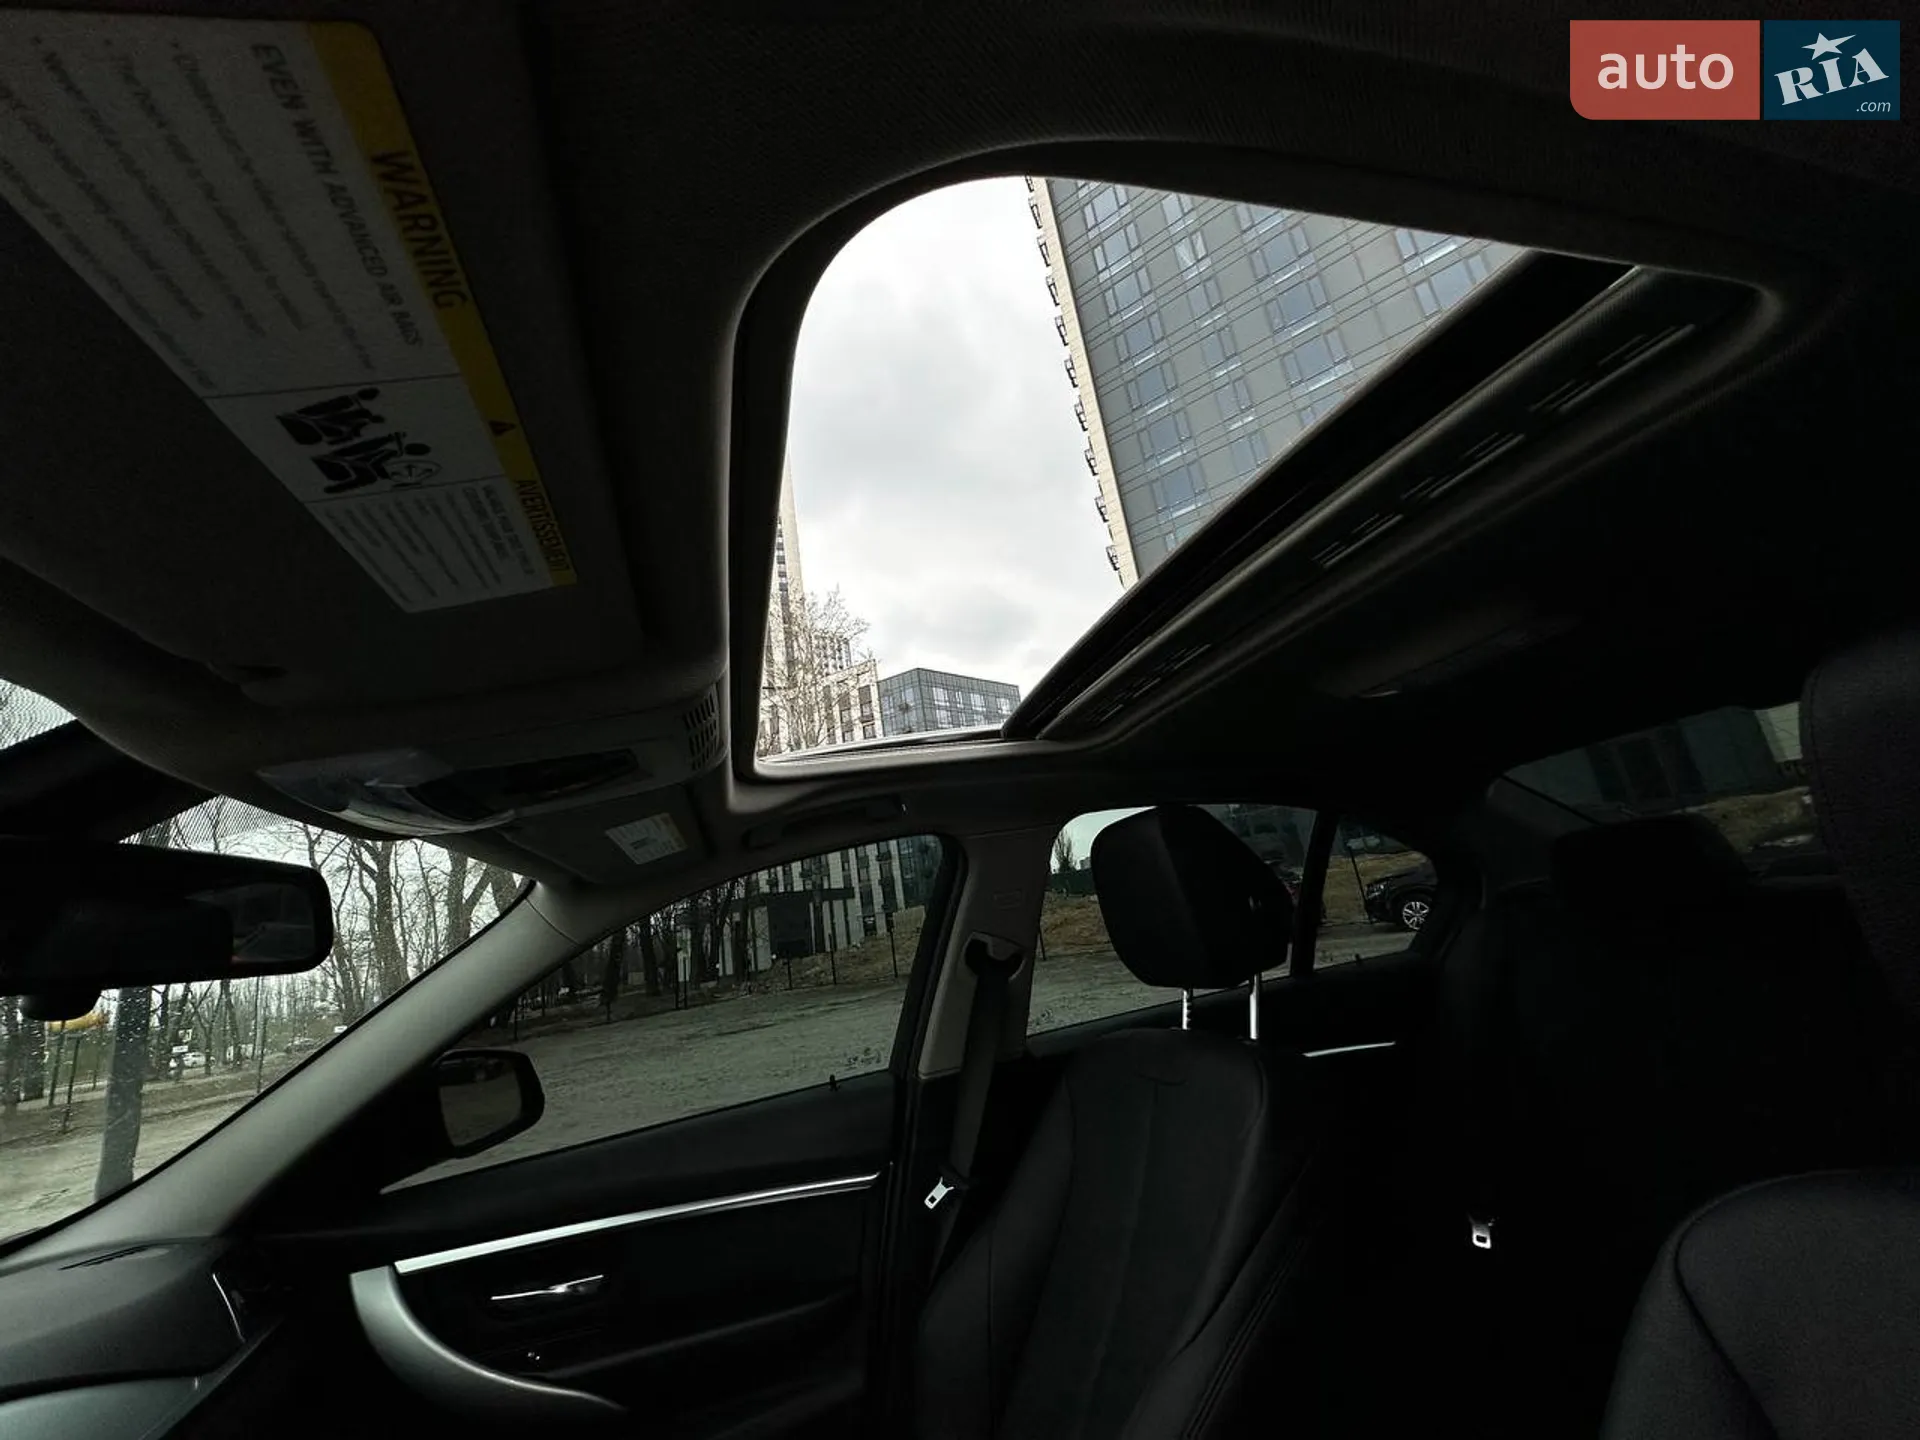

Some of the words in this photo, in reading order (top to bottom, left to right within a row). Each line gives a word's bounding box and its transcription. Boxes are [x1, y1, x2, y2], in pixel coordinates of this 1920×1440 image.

[252, 44, 307, 109] EVEN
[292, 120, 339, 175] WITH
[325, 183, 389, 278] ADVANCED
[370, 152, 468, 308] WARNING
[378, 283, 405, 307] AIR
[391, 311, 425, 347] BAGS
[514, 479, 570, 572] AVERTISSEMENT
